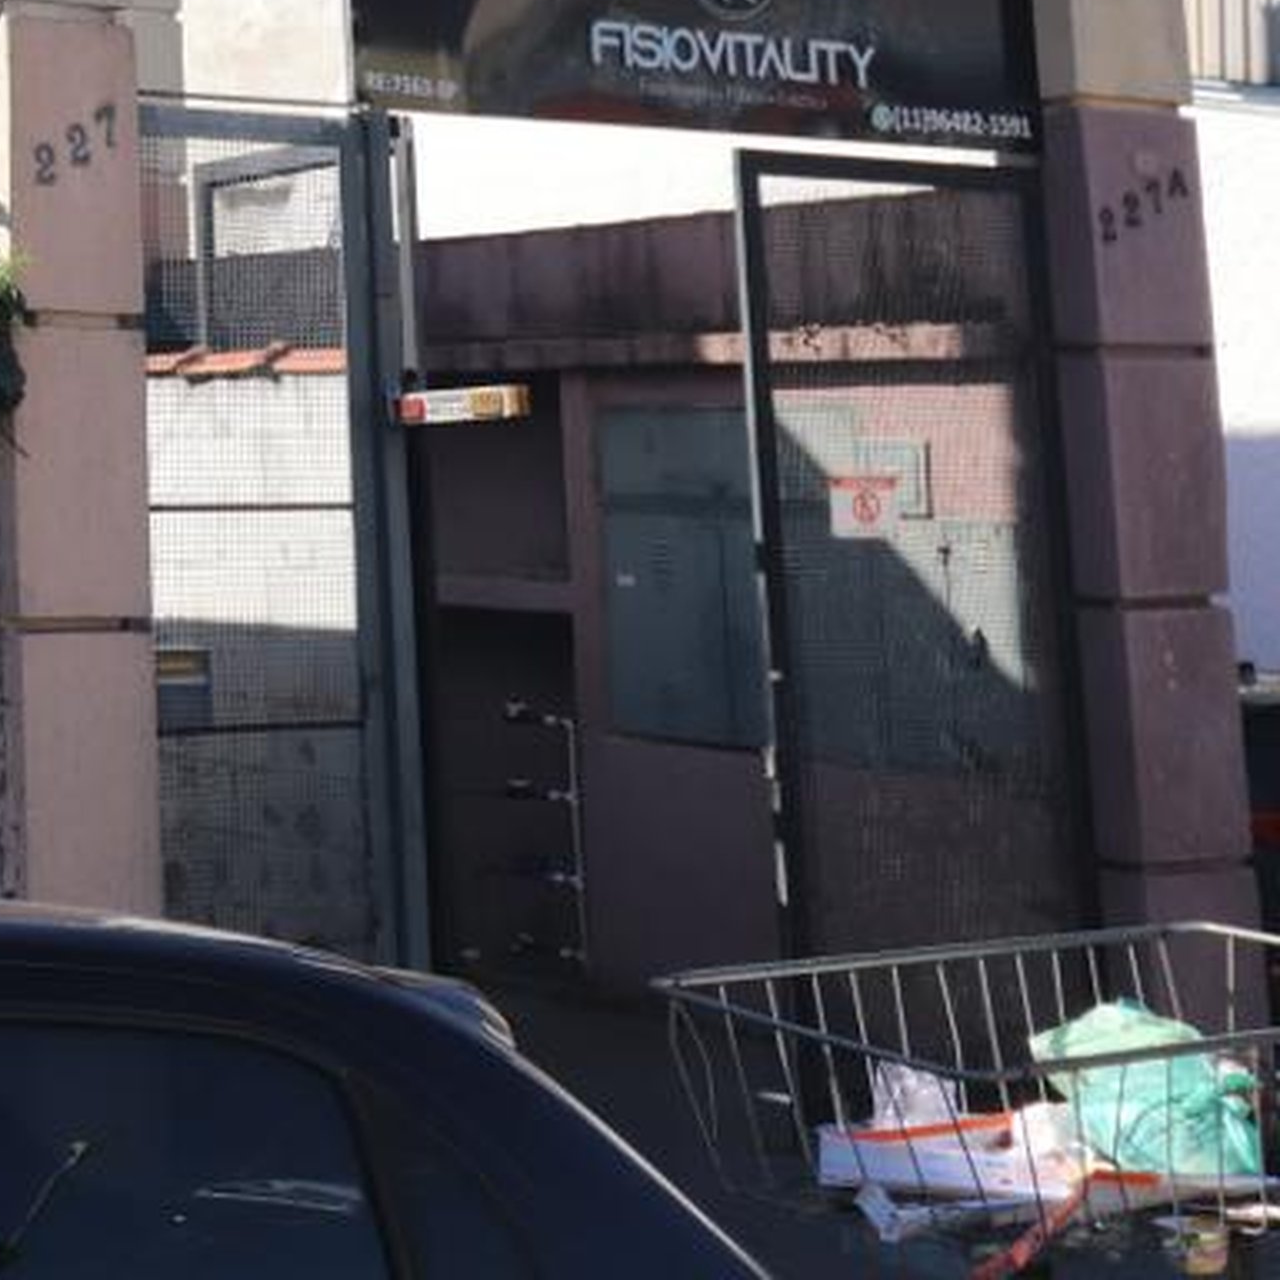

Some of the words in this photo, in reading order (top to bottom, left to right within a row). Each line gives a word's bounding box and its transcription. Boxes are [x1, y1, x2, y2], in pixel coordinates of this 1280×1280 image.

[591, 20, 875, 89] FISIOVITALITY
[34, 103, 117, 187] 227
[1098, 167, 1190, 242] 227A
